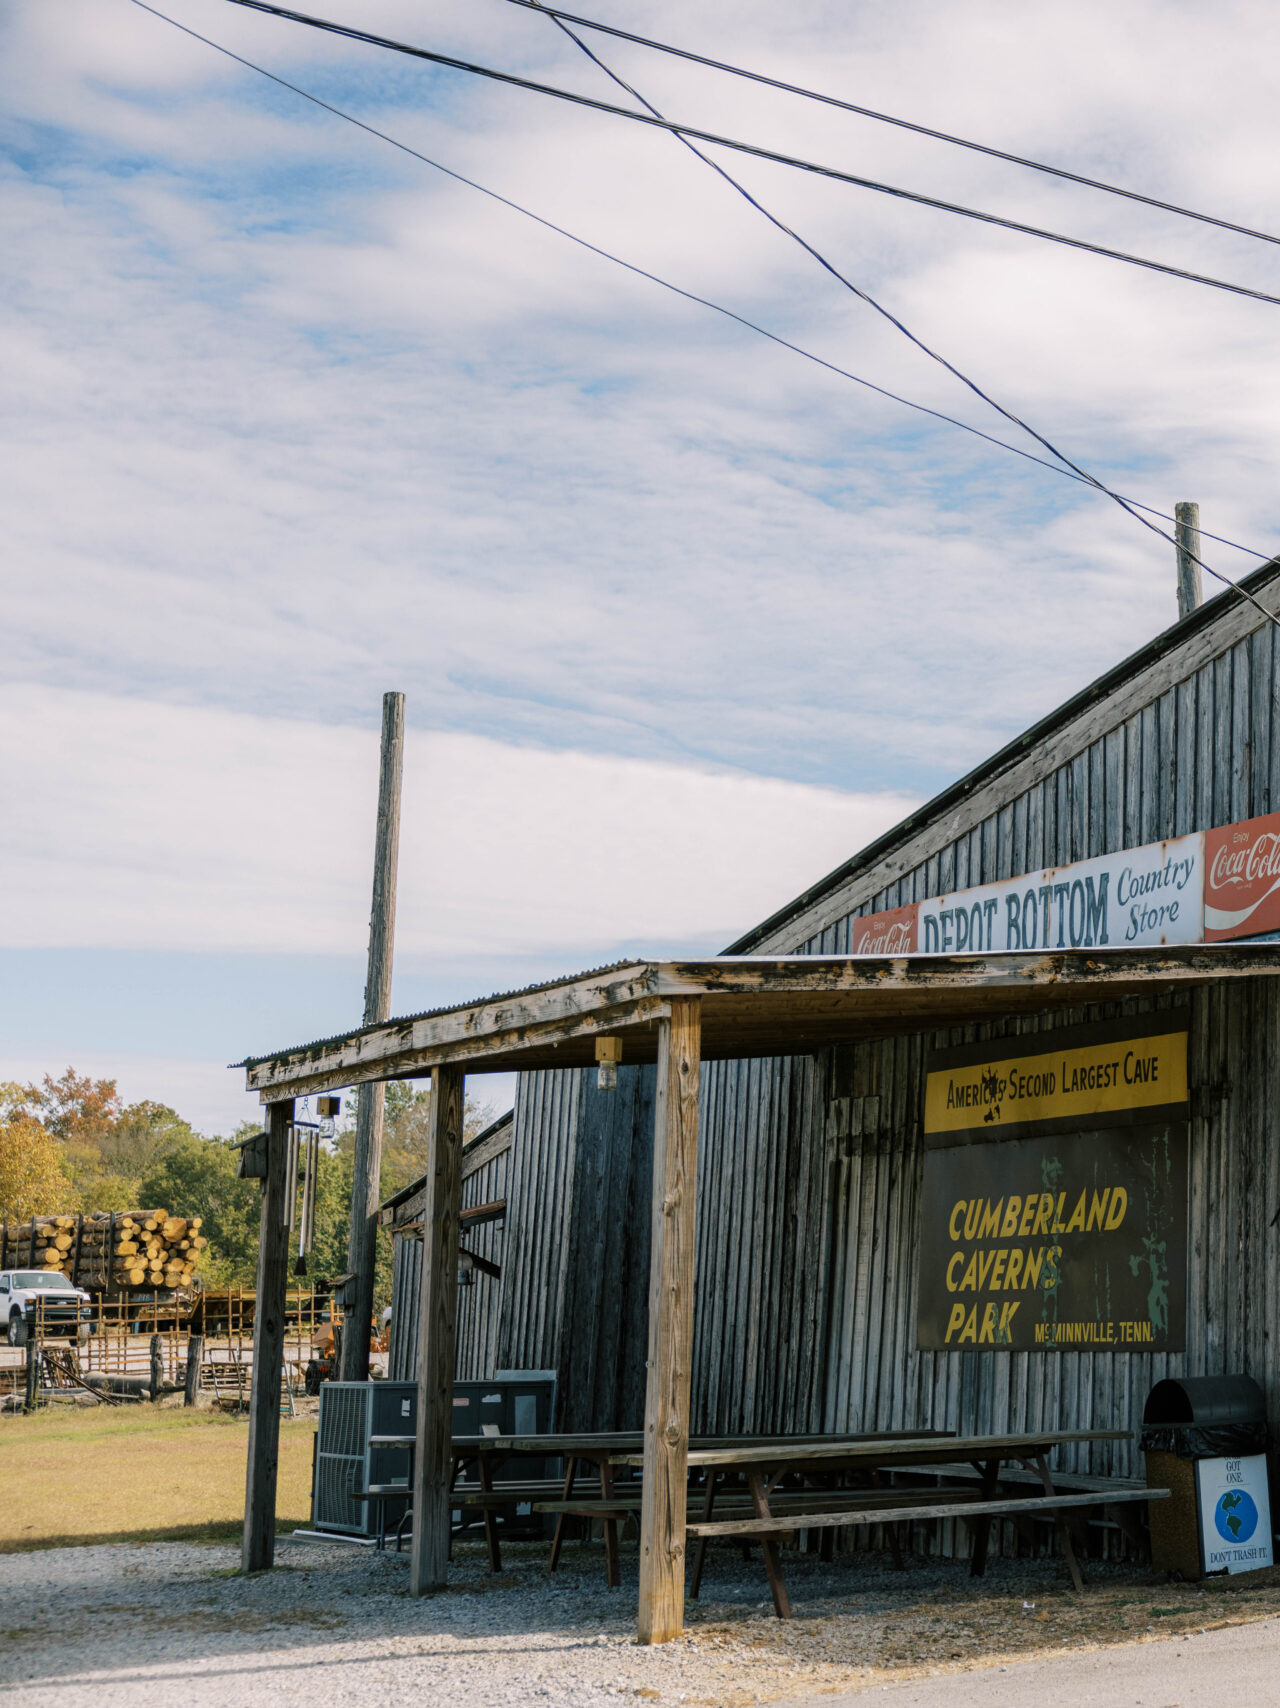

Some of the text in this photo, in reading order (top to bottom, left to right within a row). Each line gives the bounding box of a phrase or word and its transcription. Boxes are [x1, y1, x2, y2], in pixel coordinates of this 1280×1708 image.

[1233, 832, 1249, 843] Enjoy
[1117, 854, 1195, 907] Country
[1005, 872, 1110, 949] BOTTOM
[1126, 899, 1179, 941] Store
[1009, 1068, 1056, 1100] SECOND
[1062, 1061, 1120, 1093] LARGEST
[1124, 1051, 1159, 1085] CAVE
[949, 1186, 1128, 1241] CUMBERLAND
[946, 1245, 1063, 1293] CAVERNS
[944, 1301, 1021, 1344] PARK
[1119, 1321, 1154, 1343] TENN.
[1226, 1461, 1241, 1472] GOT
[1233, 1549, 1258, 1561] TRASH
